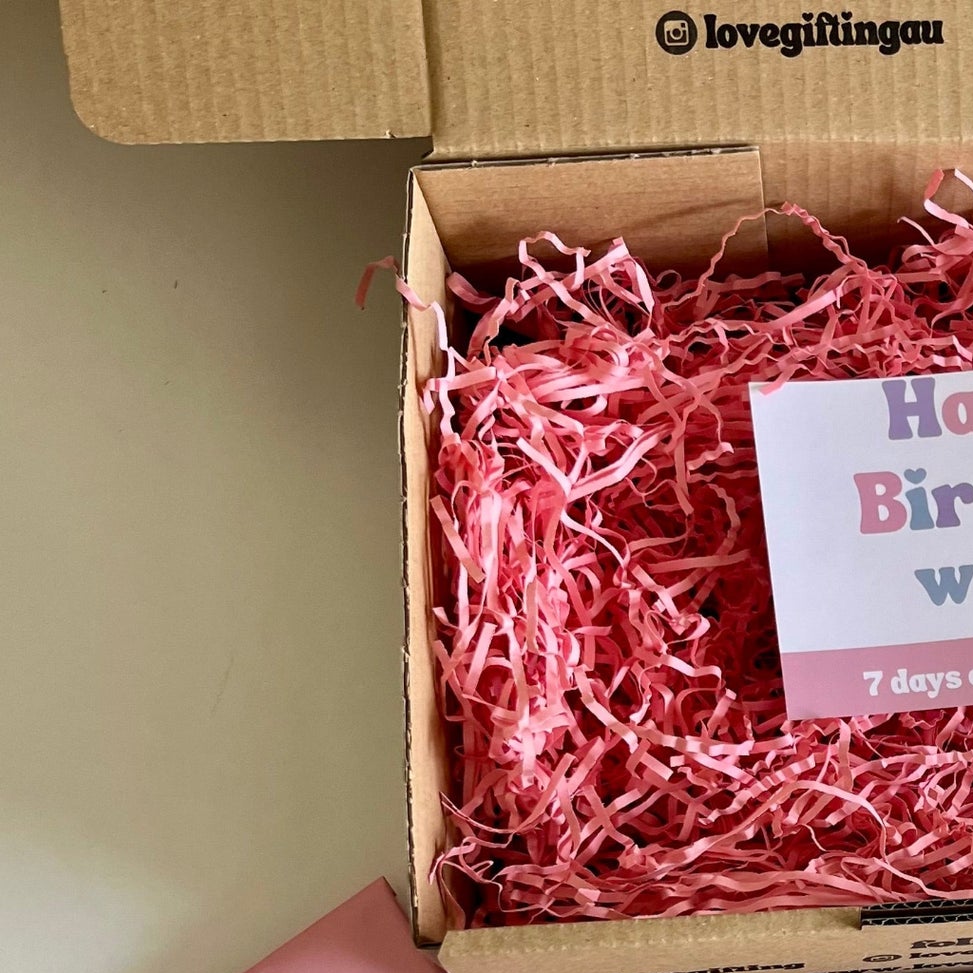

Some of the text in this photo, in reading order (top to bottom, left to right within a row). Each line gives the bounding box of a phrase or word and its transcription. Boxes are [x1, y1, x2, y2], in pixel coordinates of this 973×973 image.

[705, 12, 944, 57] lovegiftingau
[863, 671, 884, 696] 7
[890, 665, 962, 698] days
